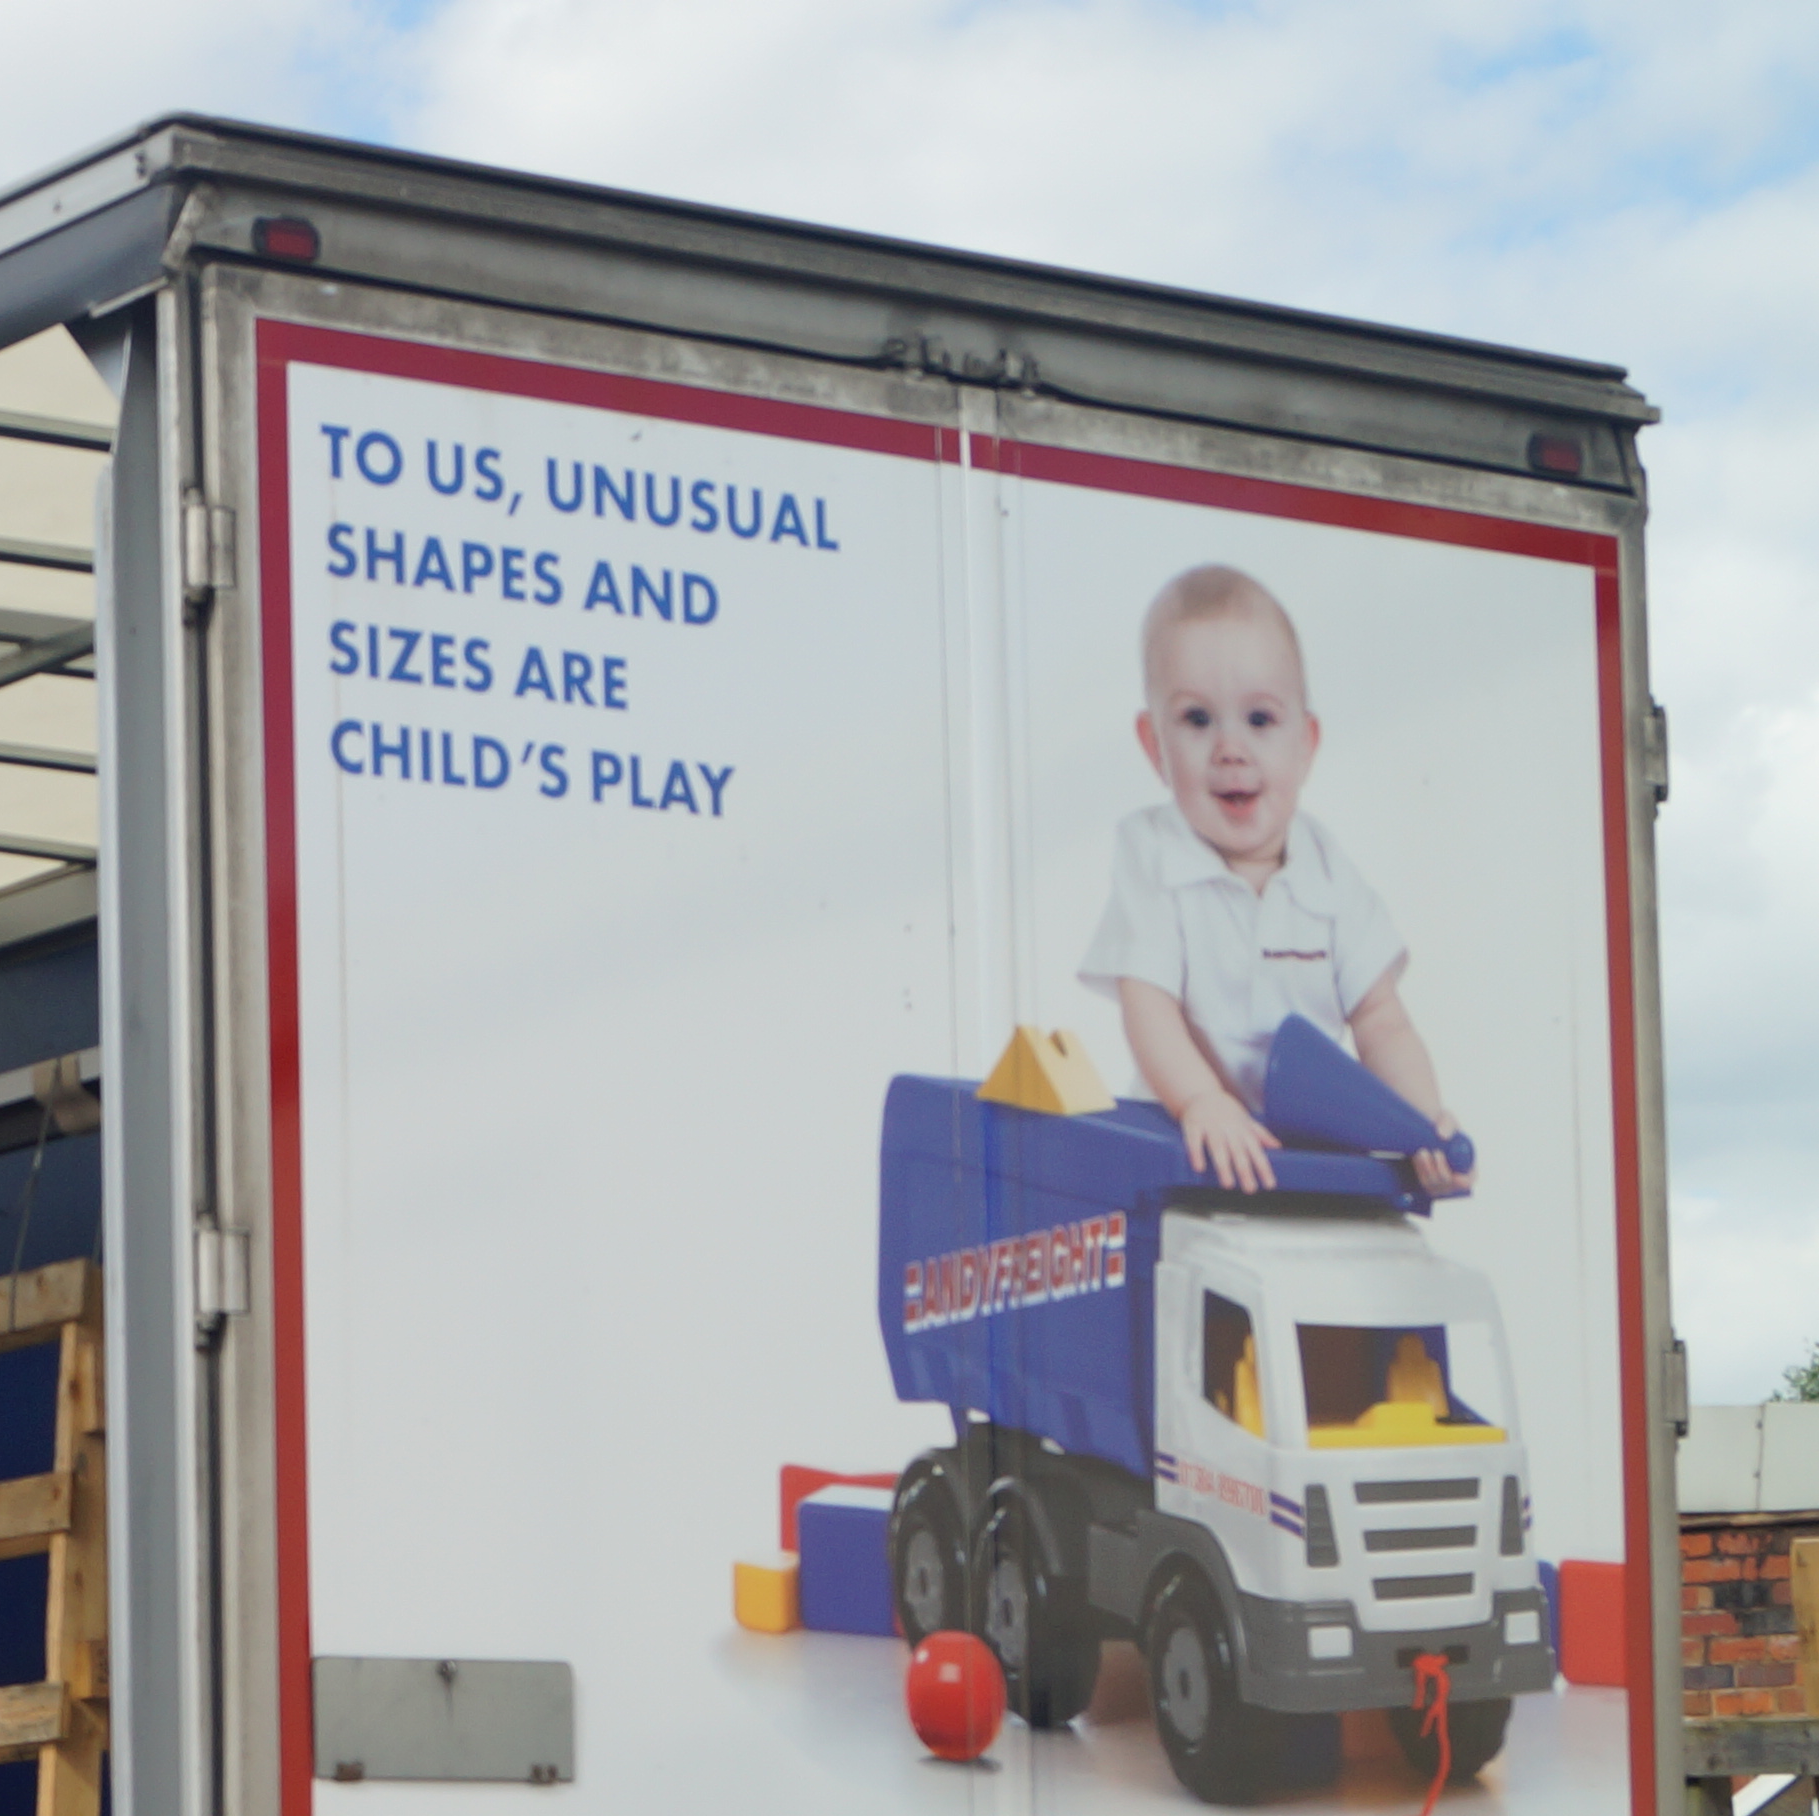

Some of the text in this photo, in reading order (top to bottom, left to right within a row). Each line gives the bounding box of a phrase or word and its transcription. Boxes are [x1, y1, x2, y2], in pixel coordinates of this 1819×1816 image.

[320, 423, 840, 551] TO US, UNUSUAL
[326, 521, 720, 625] SHAPES AND
[329, 619, 628, 710] SIZES ARE
[329, 718, 734, 816] CHILD'S PLAY
